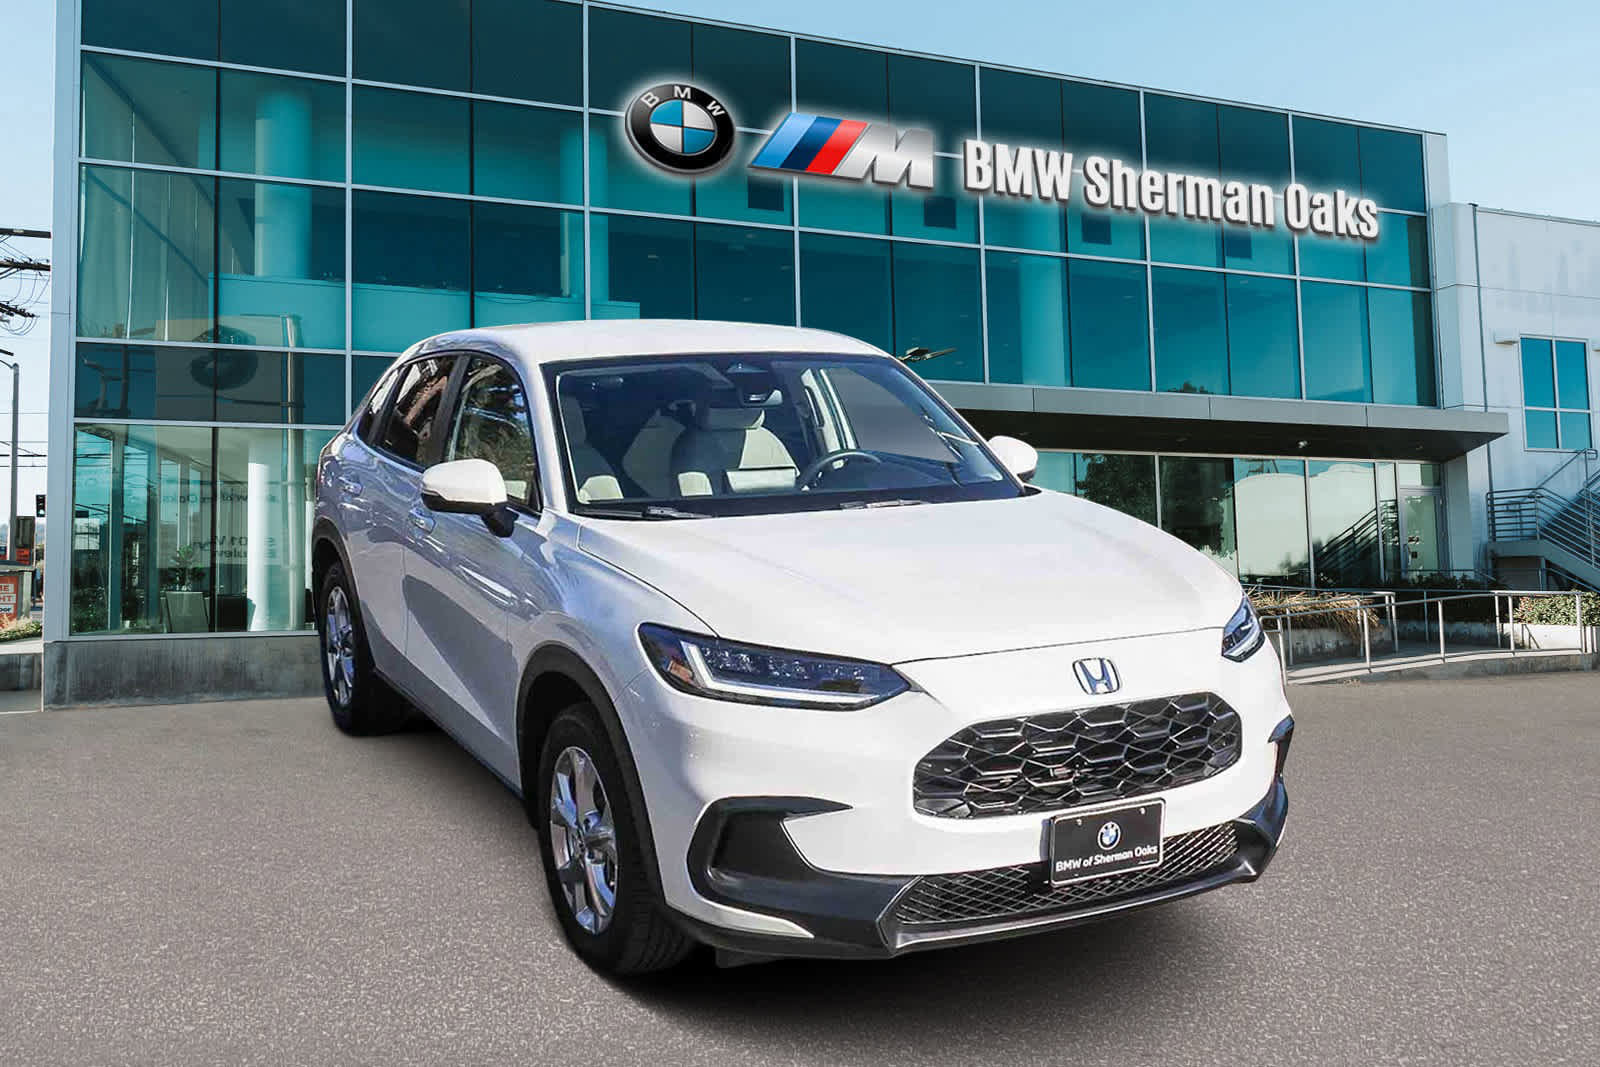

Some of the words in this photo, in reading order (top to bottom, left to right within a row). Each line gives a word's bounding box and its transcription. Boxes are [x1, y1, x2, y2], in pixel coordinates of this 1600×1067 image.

[641, 85, 726, 118] BMW
[963, 139, 1074, 201] BMW
[1083, 156, 1275, 227] Sherman
[1284, 183, 1380, 241] Oaks
[1055, 858, 1082, 872] BMW
[1082, 855, 1094, 868] of
[1094, 850, 1133, 866] Sherman
[1134, 845, 1159, 858] Oaks
